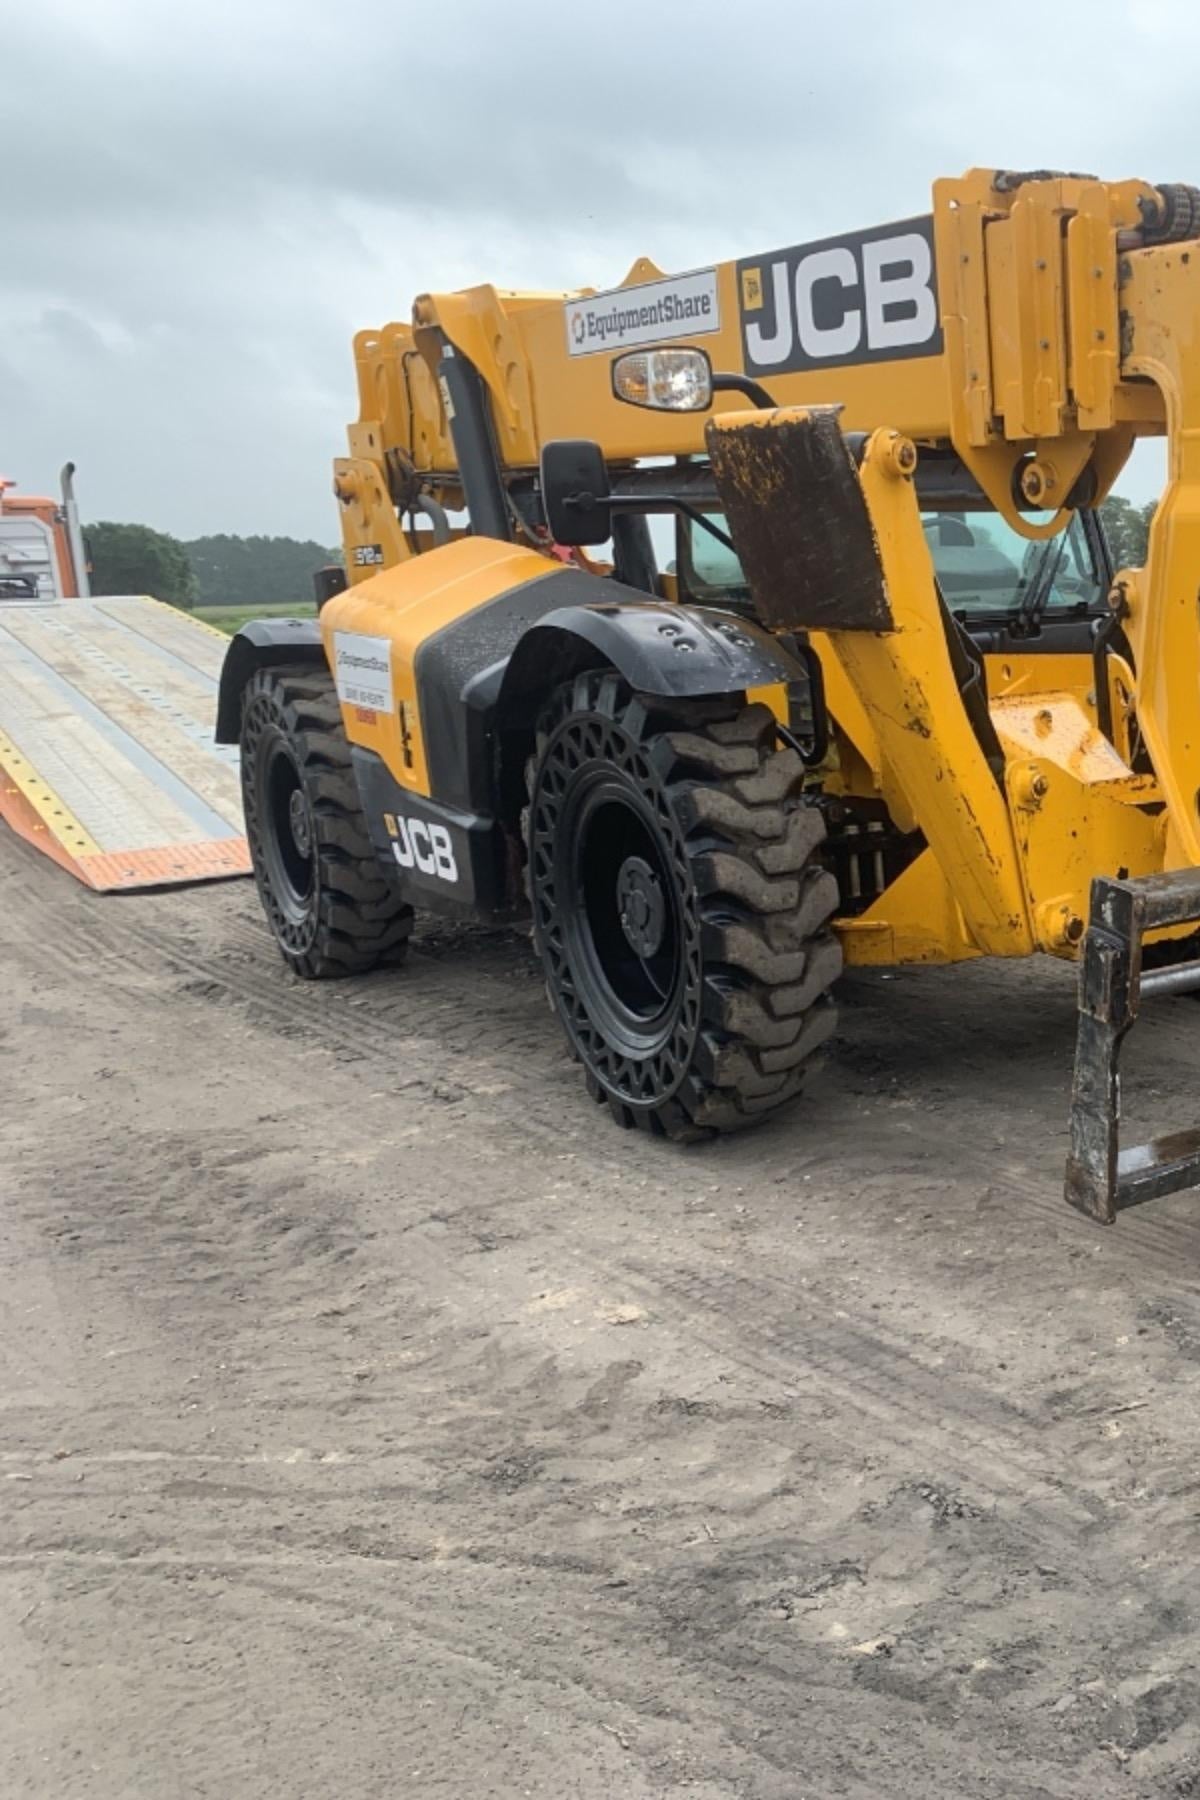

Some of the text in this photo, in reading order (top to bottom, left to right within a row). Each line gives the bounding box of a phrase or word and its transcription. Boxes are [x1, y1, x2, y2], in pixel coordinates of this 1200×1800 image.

[585, 293, 712, 338] EquipmentShare
[745, 232, 938, 367] JCB
[391, 814, 458, 882] JCB
